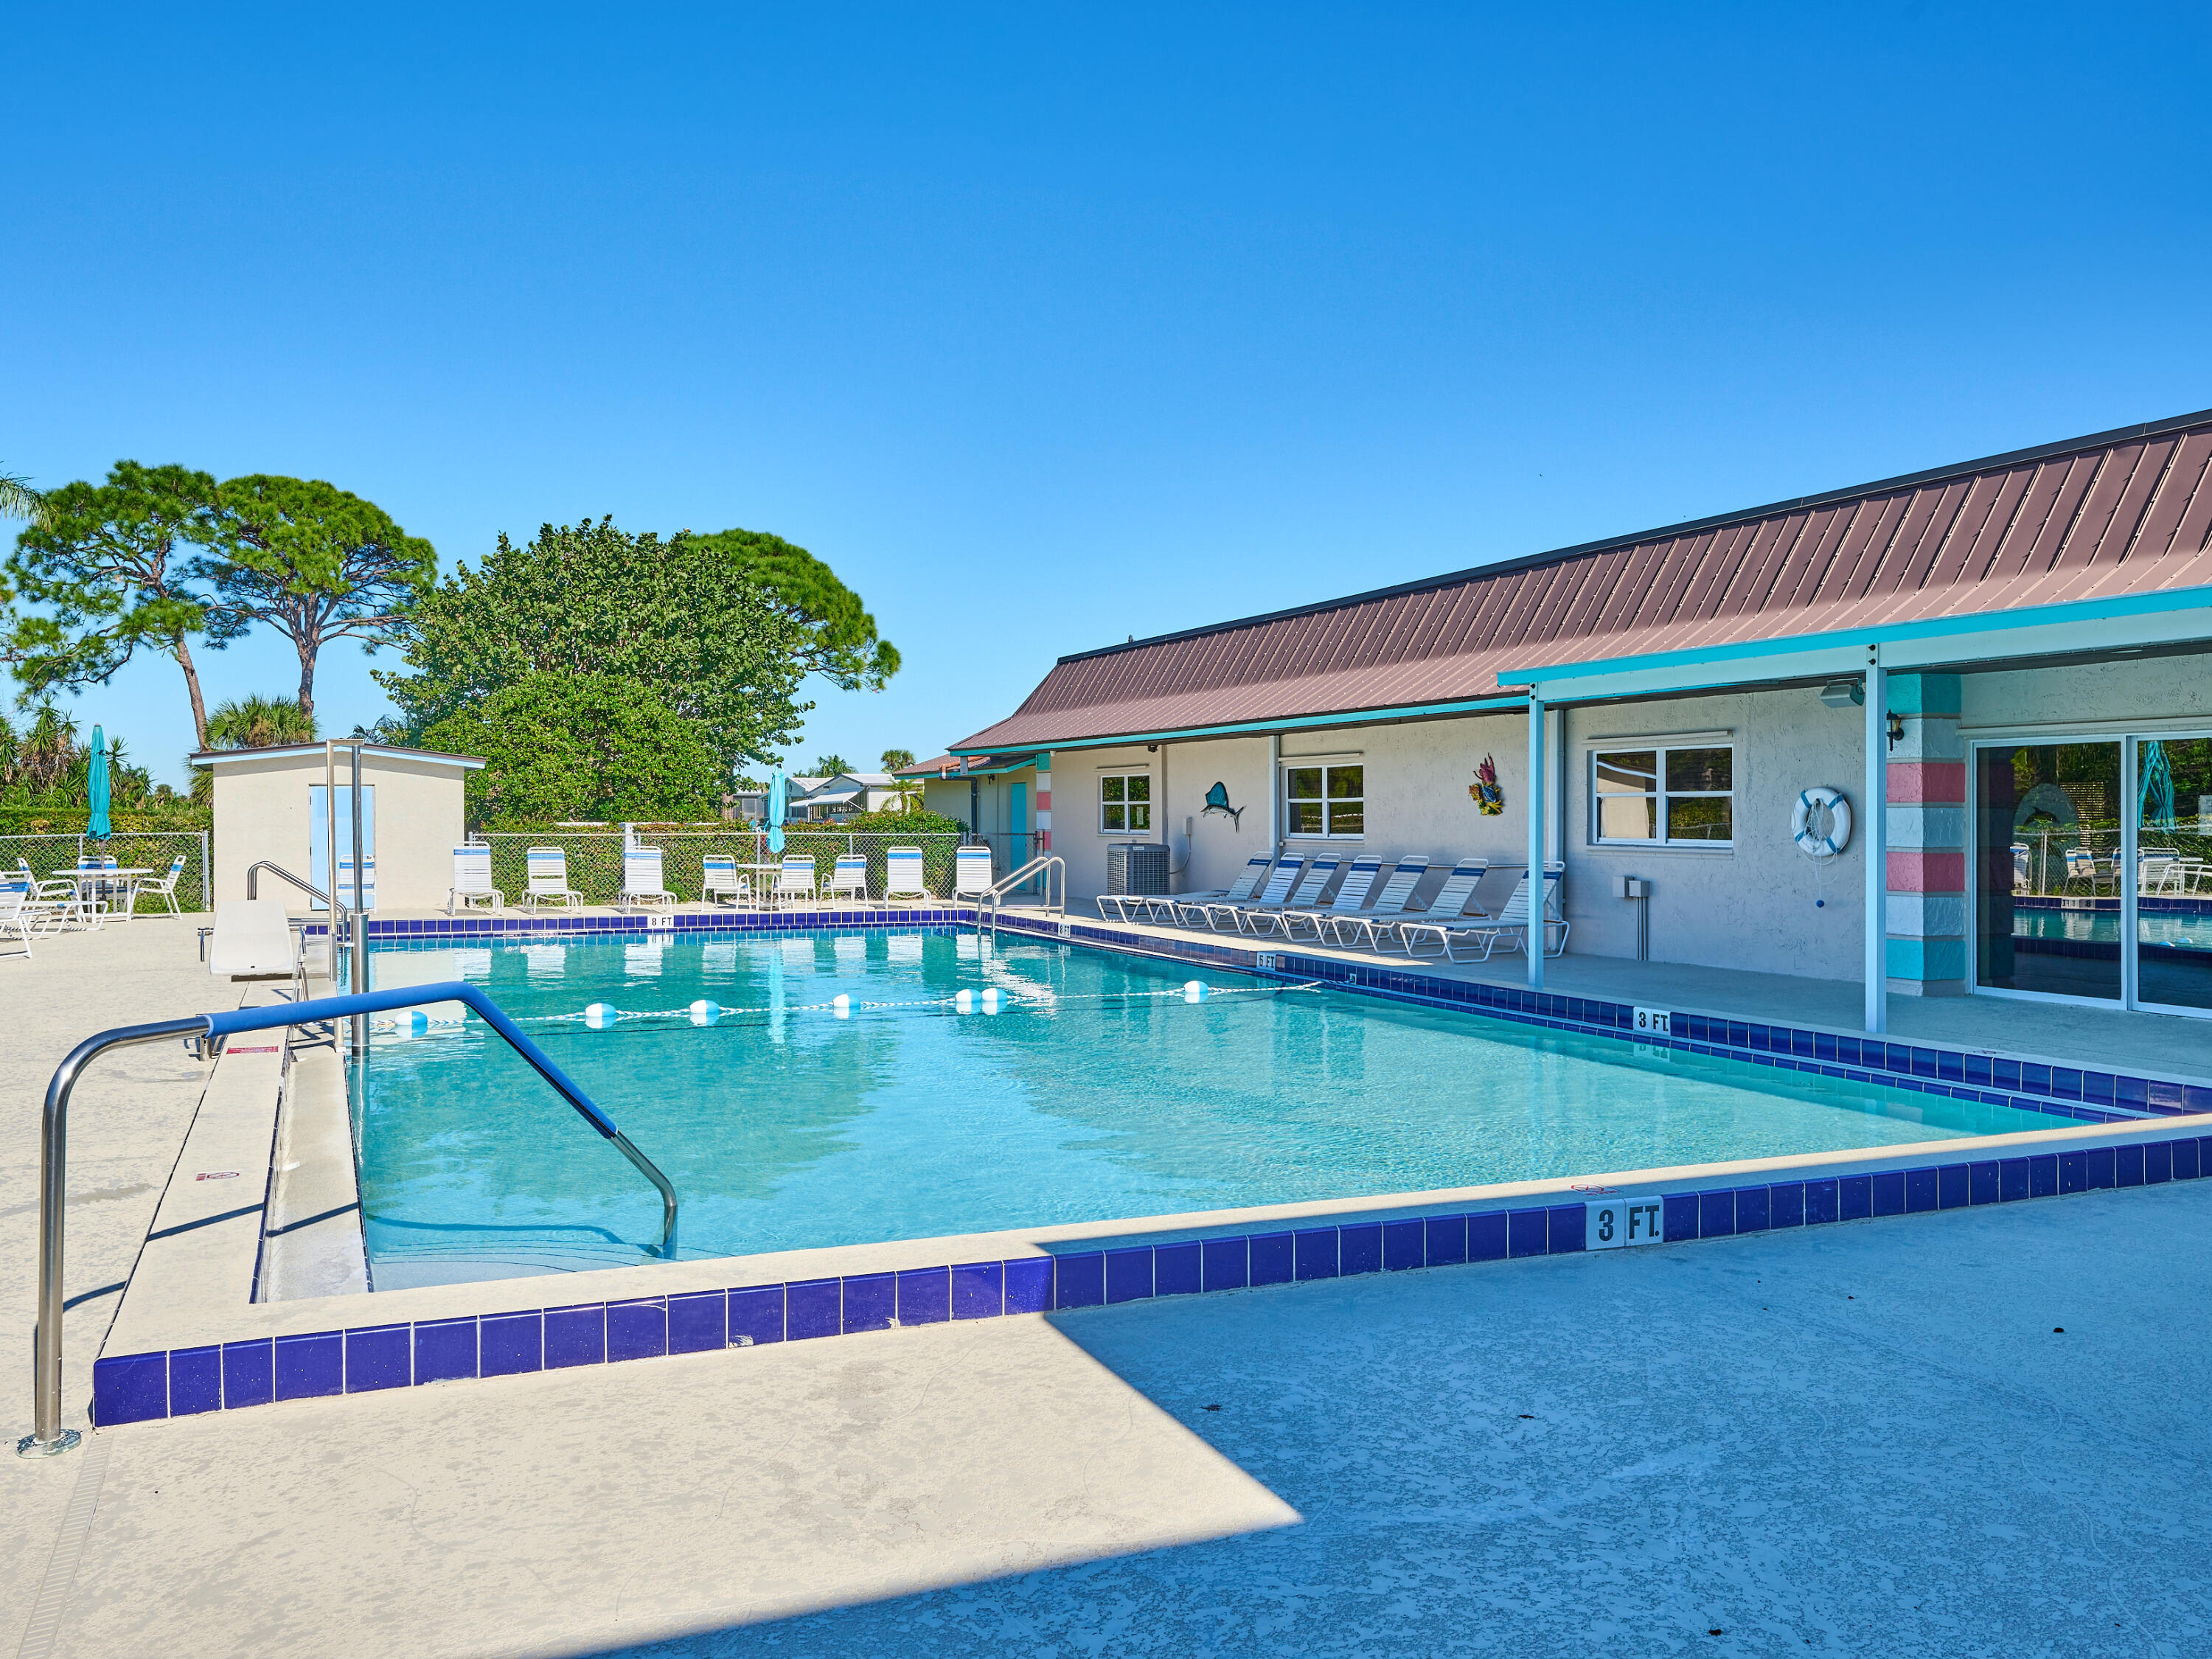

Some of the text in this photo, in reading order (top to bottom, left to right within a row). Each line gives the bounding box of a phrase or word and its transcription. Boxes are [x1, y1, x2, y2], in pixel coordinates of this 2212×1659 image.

[651, 917, 657, 926] 8
[1060, 925, 1062, 934] 8
[1259, 955, 1264, 967] 5
[1639, 1012, 1669, 1032] 3 FT.
[1599, 1204, 1660, 1241] 3 FT.
